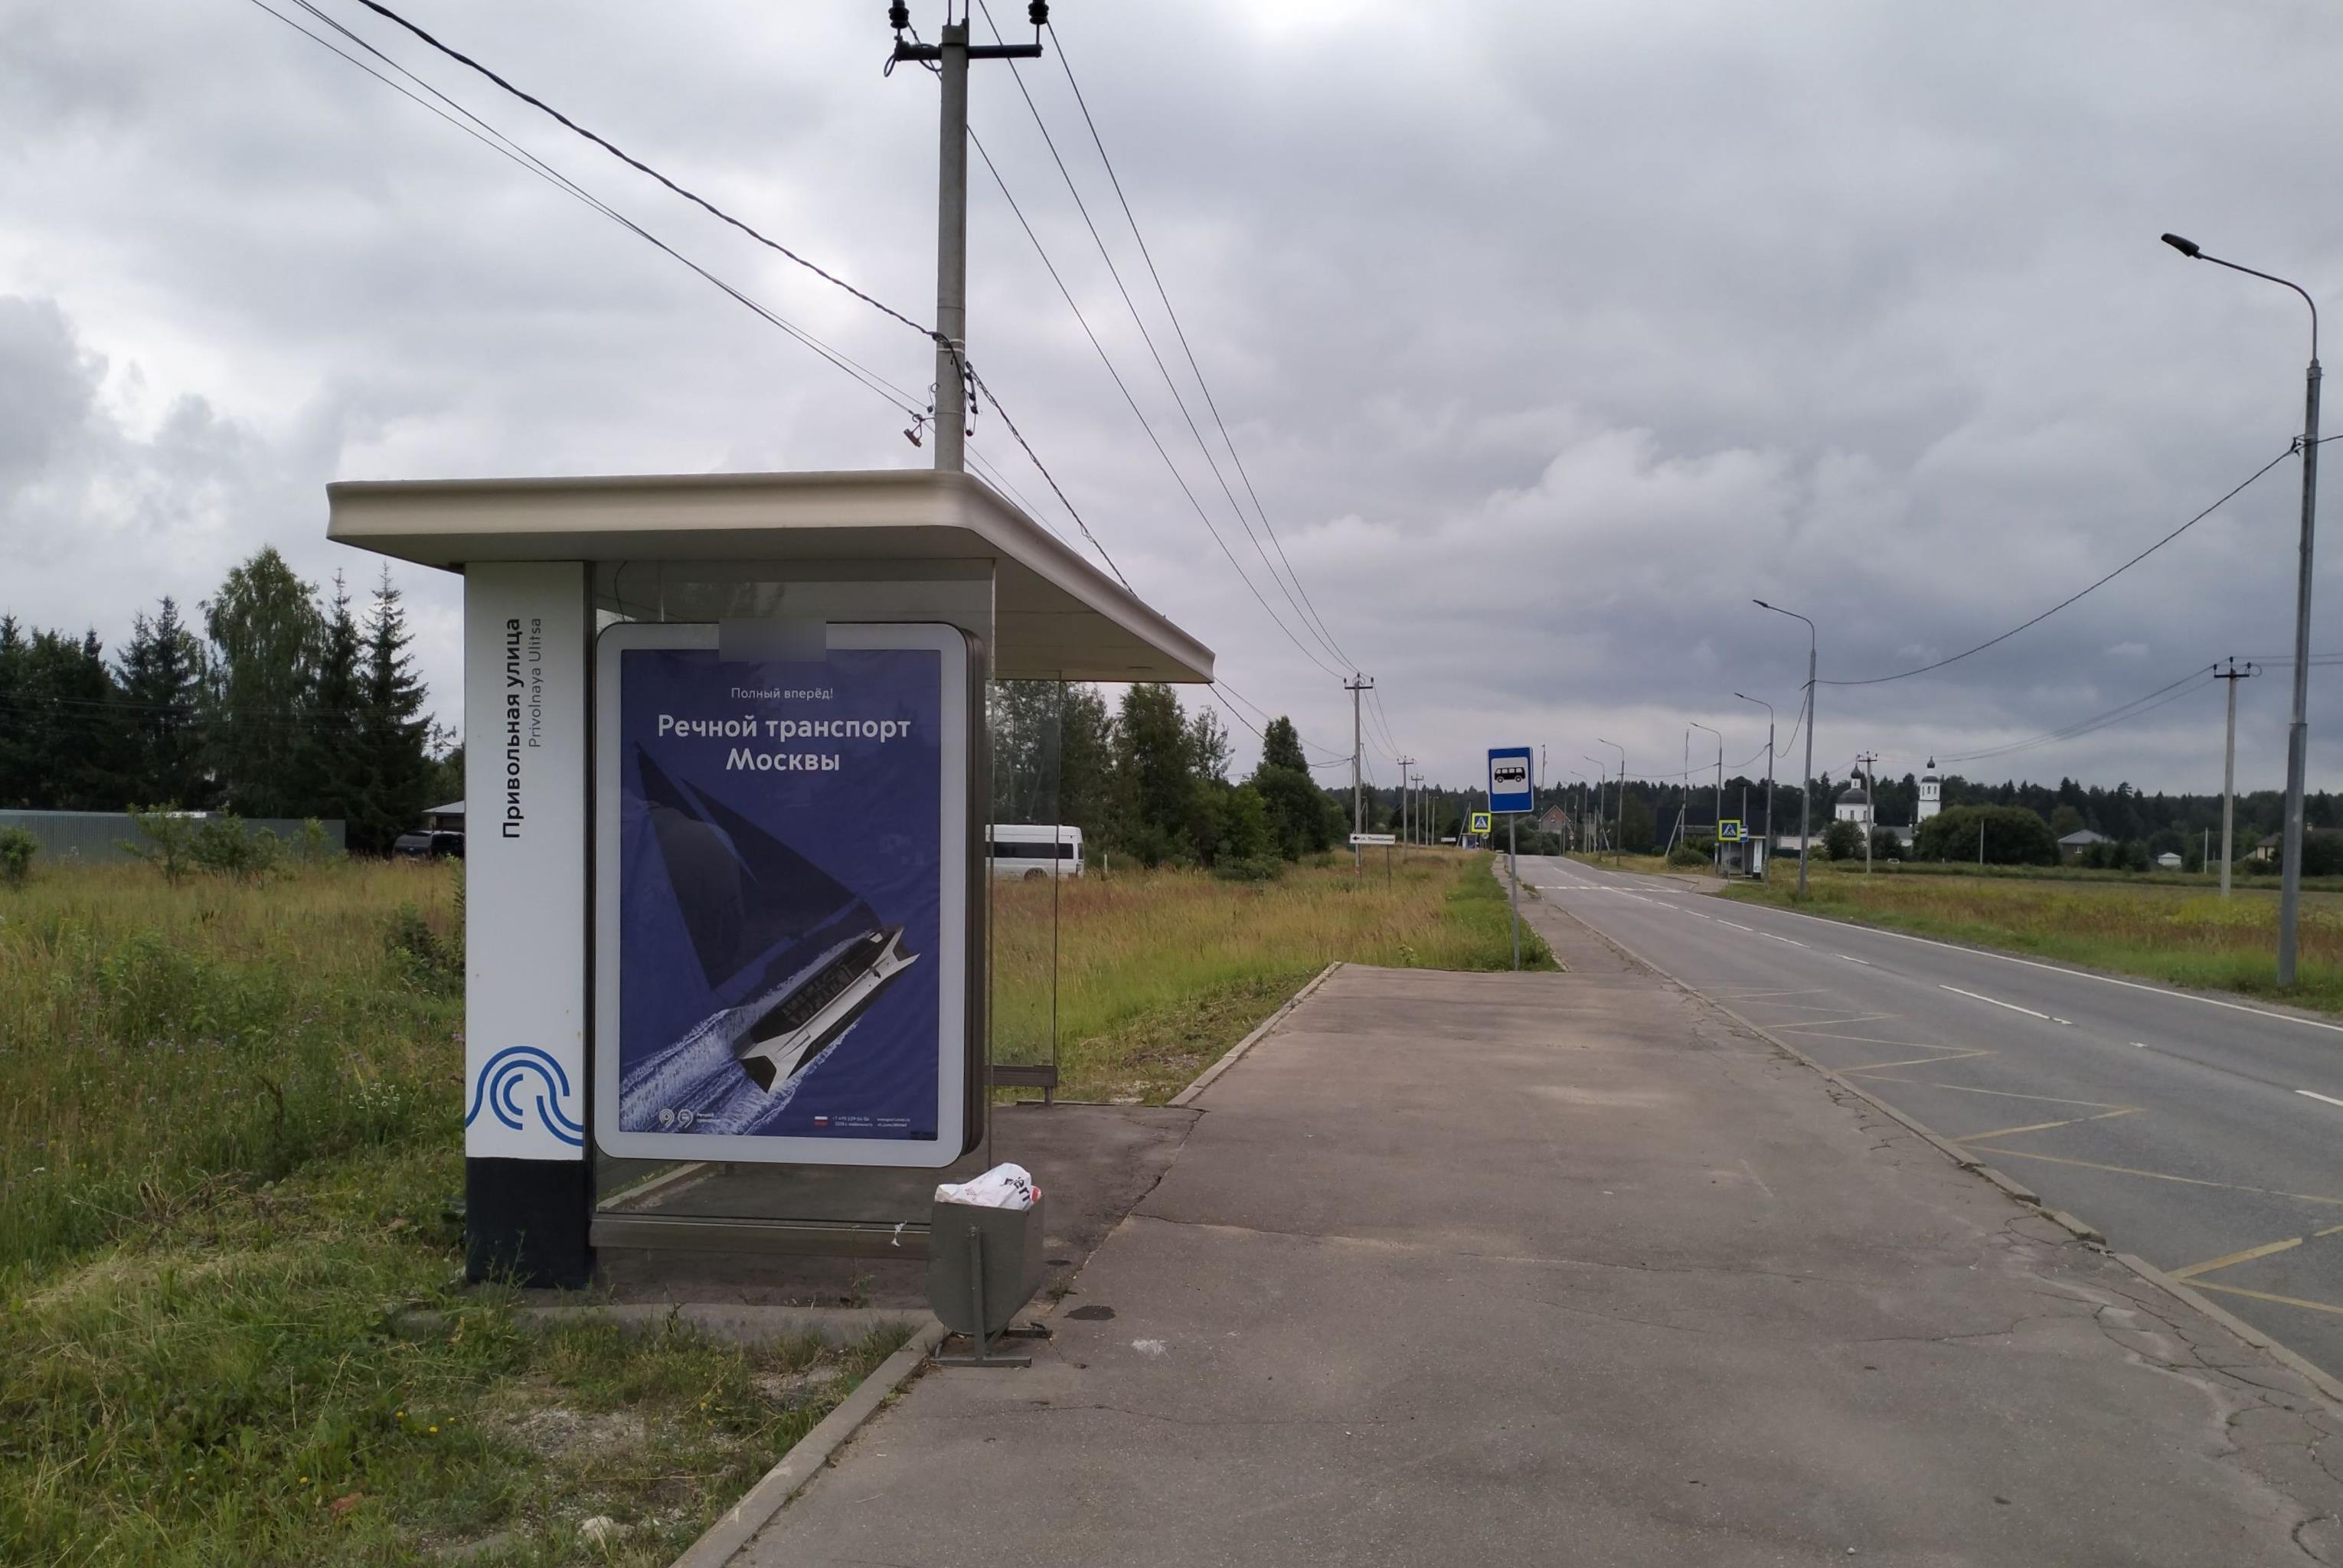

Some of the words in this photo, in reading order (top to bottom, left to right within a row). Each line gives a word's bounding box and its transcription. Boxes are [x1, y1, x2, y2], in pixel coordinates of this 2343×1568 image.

[506, 619, 523, 688] улица
[528, 618, 541, 662] Ulitsa
[528, 668, 544, 748] Privolnaya
[731, 688, 780, 698] Полный
[784, 687, 833, 701] вперёд!
[658, 714, 757, 737] Речной
[765, 720, 911, 742] транспорт
[502, 694, 524, 838] Привольная
[726, 748, 840, 771] Москвы
